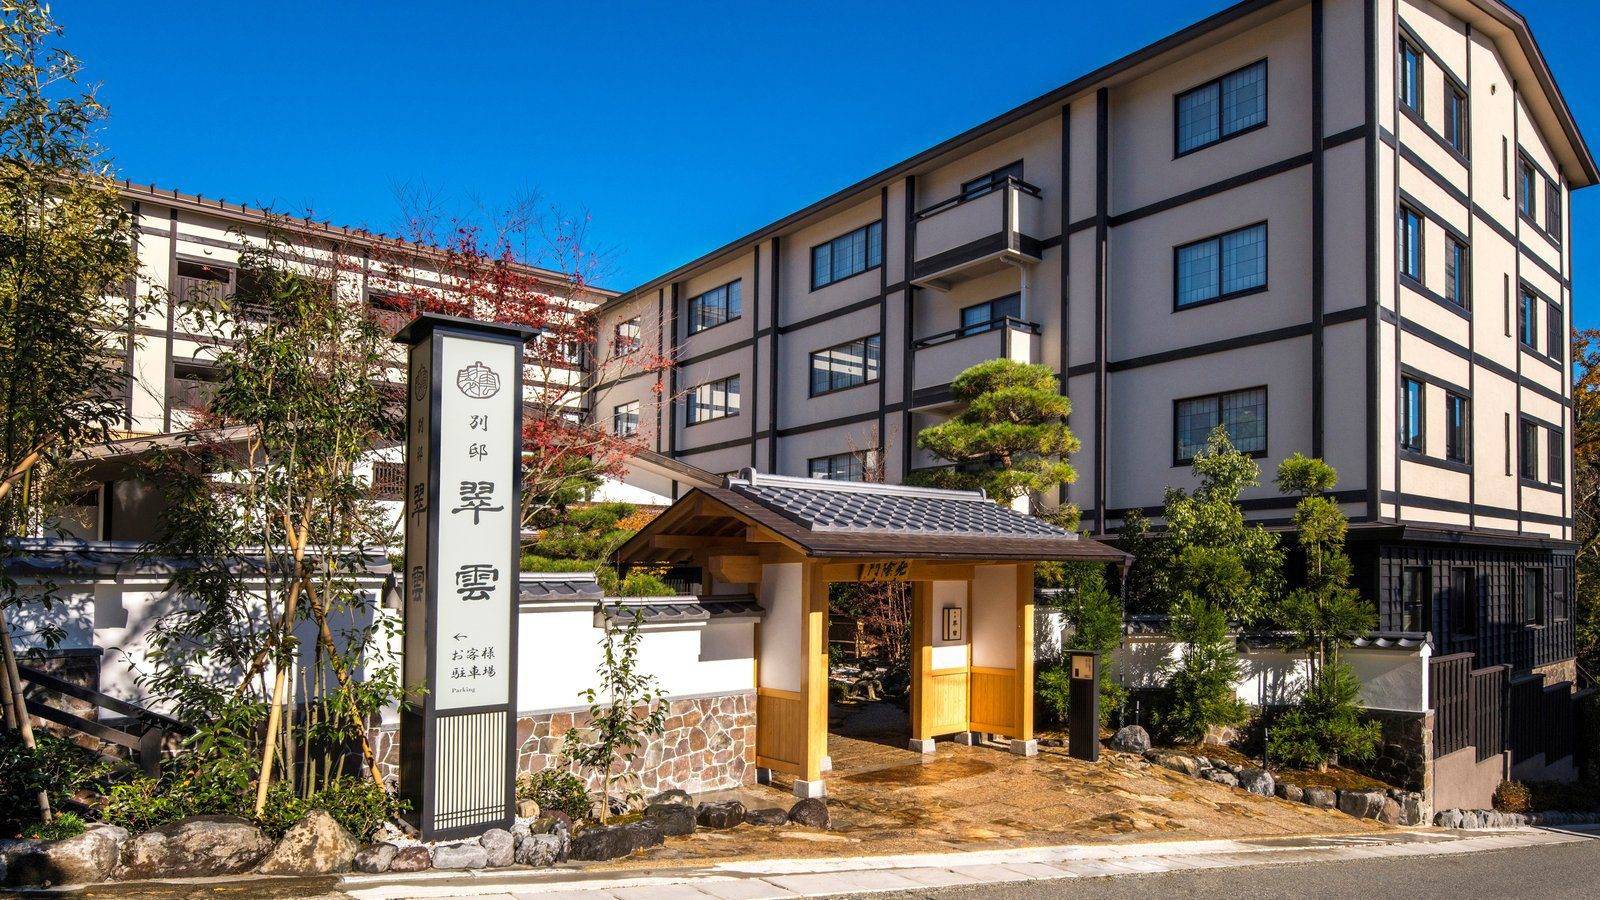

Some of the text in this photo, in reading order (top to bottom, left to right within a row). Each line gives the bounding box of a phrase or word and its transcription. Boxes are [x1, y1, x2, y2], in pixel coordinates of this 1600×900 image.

[468, 415, 488, 462] 別邸
[451, 480, 504, 602] 翠雲
[451, 646, 495, 661] お客様
[451, 664, 496, 680] 駐車場
[451, 686, 476, 694] Parking
